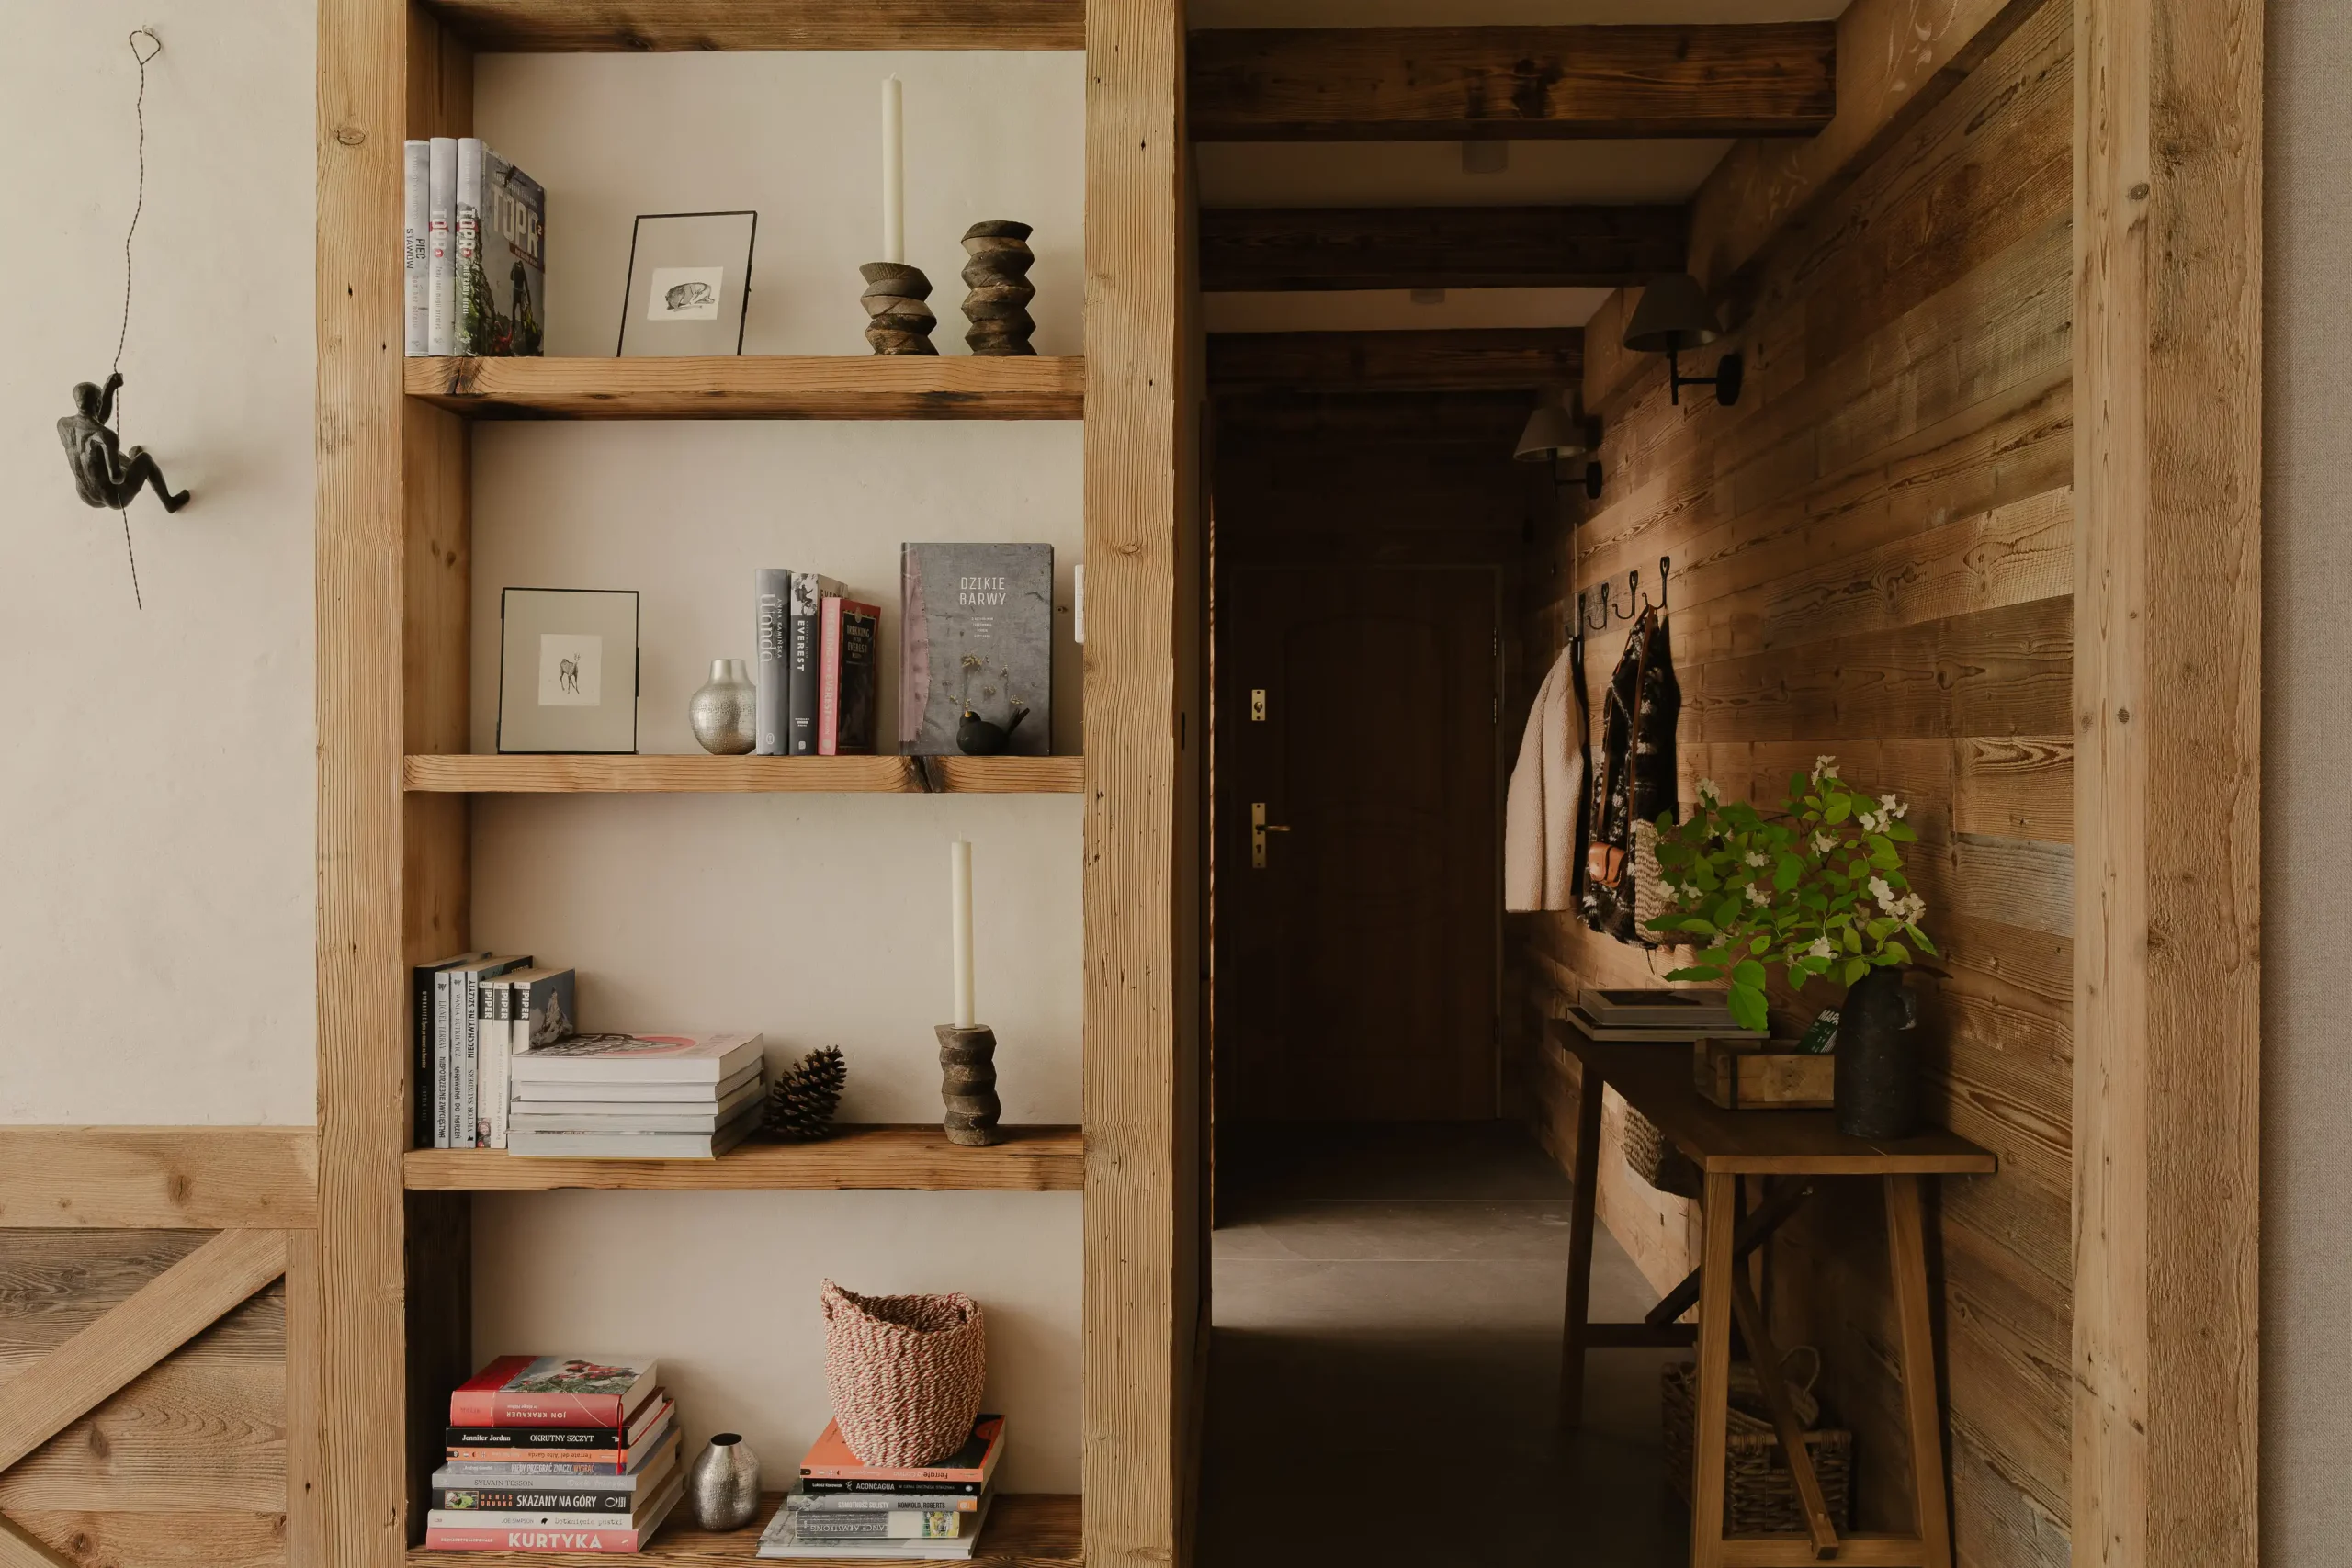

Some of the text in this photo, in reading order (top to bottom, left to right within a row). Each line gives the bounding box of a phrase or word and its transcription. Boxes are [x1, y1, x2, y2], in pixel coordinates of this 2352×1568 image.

[432, 209, 447, 250] TOPR
[458, 209, 476, 250] TOPR
[491, 182, 538, 257] TOPR
[961, 577, 1005, 590] DZIKIE
[959, 592, 1007, 605] BARWY
[759, 593, 776, 662] Wanda
[826, 607, 836, 657] TREKKING
[846, 625, 870, 638] TREKKING
[797, 620, 805, 671] EVEREST
[823, 674, 834, 715] EVEREST
[454, 993, 462, 1015] WANDA
[468, 980, 476, 1008] SZCZYTY
[484, 991, 492, 1019] PIPER
[521, 992, 529, 1019] PIPER
[438, 1000, 447, 1023] LIONEL
[438, 1026, 447, 1050] TERRAY
[467, 1009, 475, 1058] NIEUCHWYTNE
[438, 1056, 447, 1100] NIEPOTRZEBNE
[454, 1102, 461, 1112] DO
[454, 1114, 462, 1139] MARZEŃ
[550, 1411, 567, 1419] JON
[530, 1434, 565, 1442] OKRUTNY
[566, 1434, 594, 1442] SZCZYT
[511, 1464, 526, 1472] KIEDY
[526, 1462, 553, 1472] PRZEGRAĆ
[553, 1463, 573, 1472] ZNACZY
[855, 1483, 896, 1491] ACONCAGUA
[516, 1495, 557, 1507] SKAZANY
[558, 1495, 571, 1507] NA
[572, 1495, 597, 1508] GÓRY
[897, 1501, 922, 1510] HONNOLD,
[922, 1501, 945, 1509] ROBERTS
[508, 1533, 603, 1549] KURTYKA
